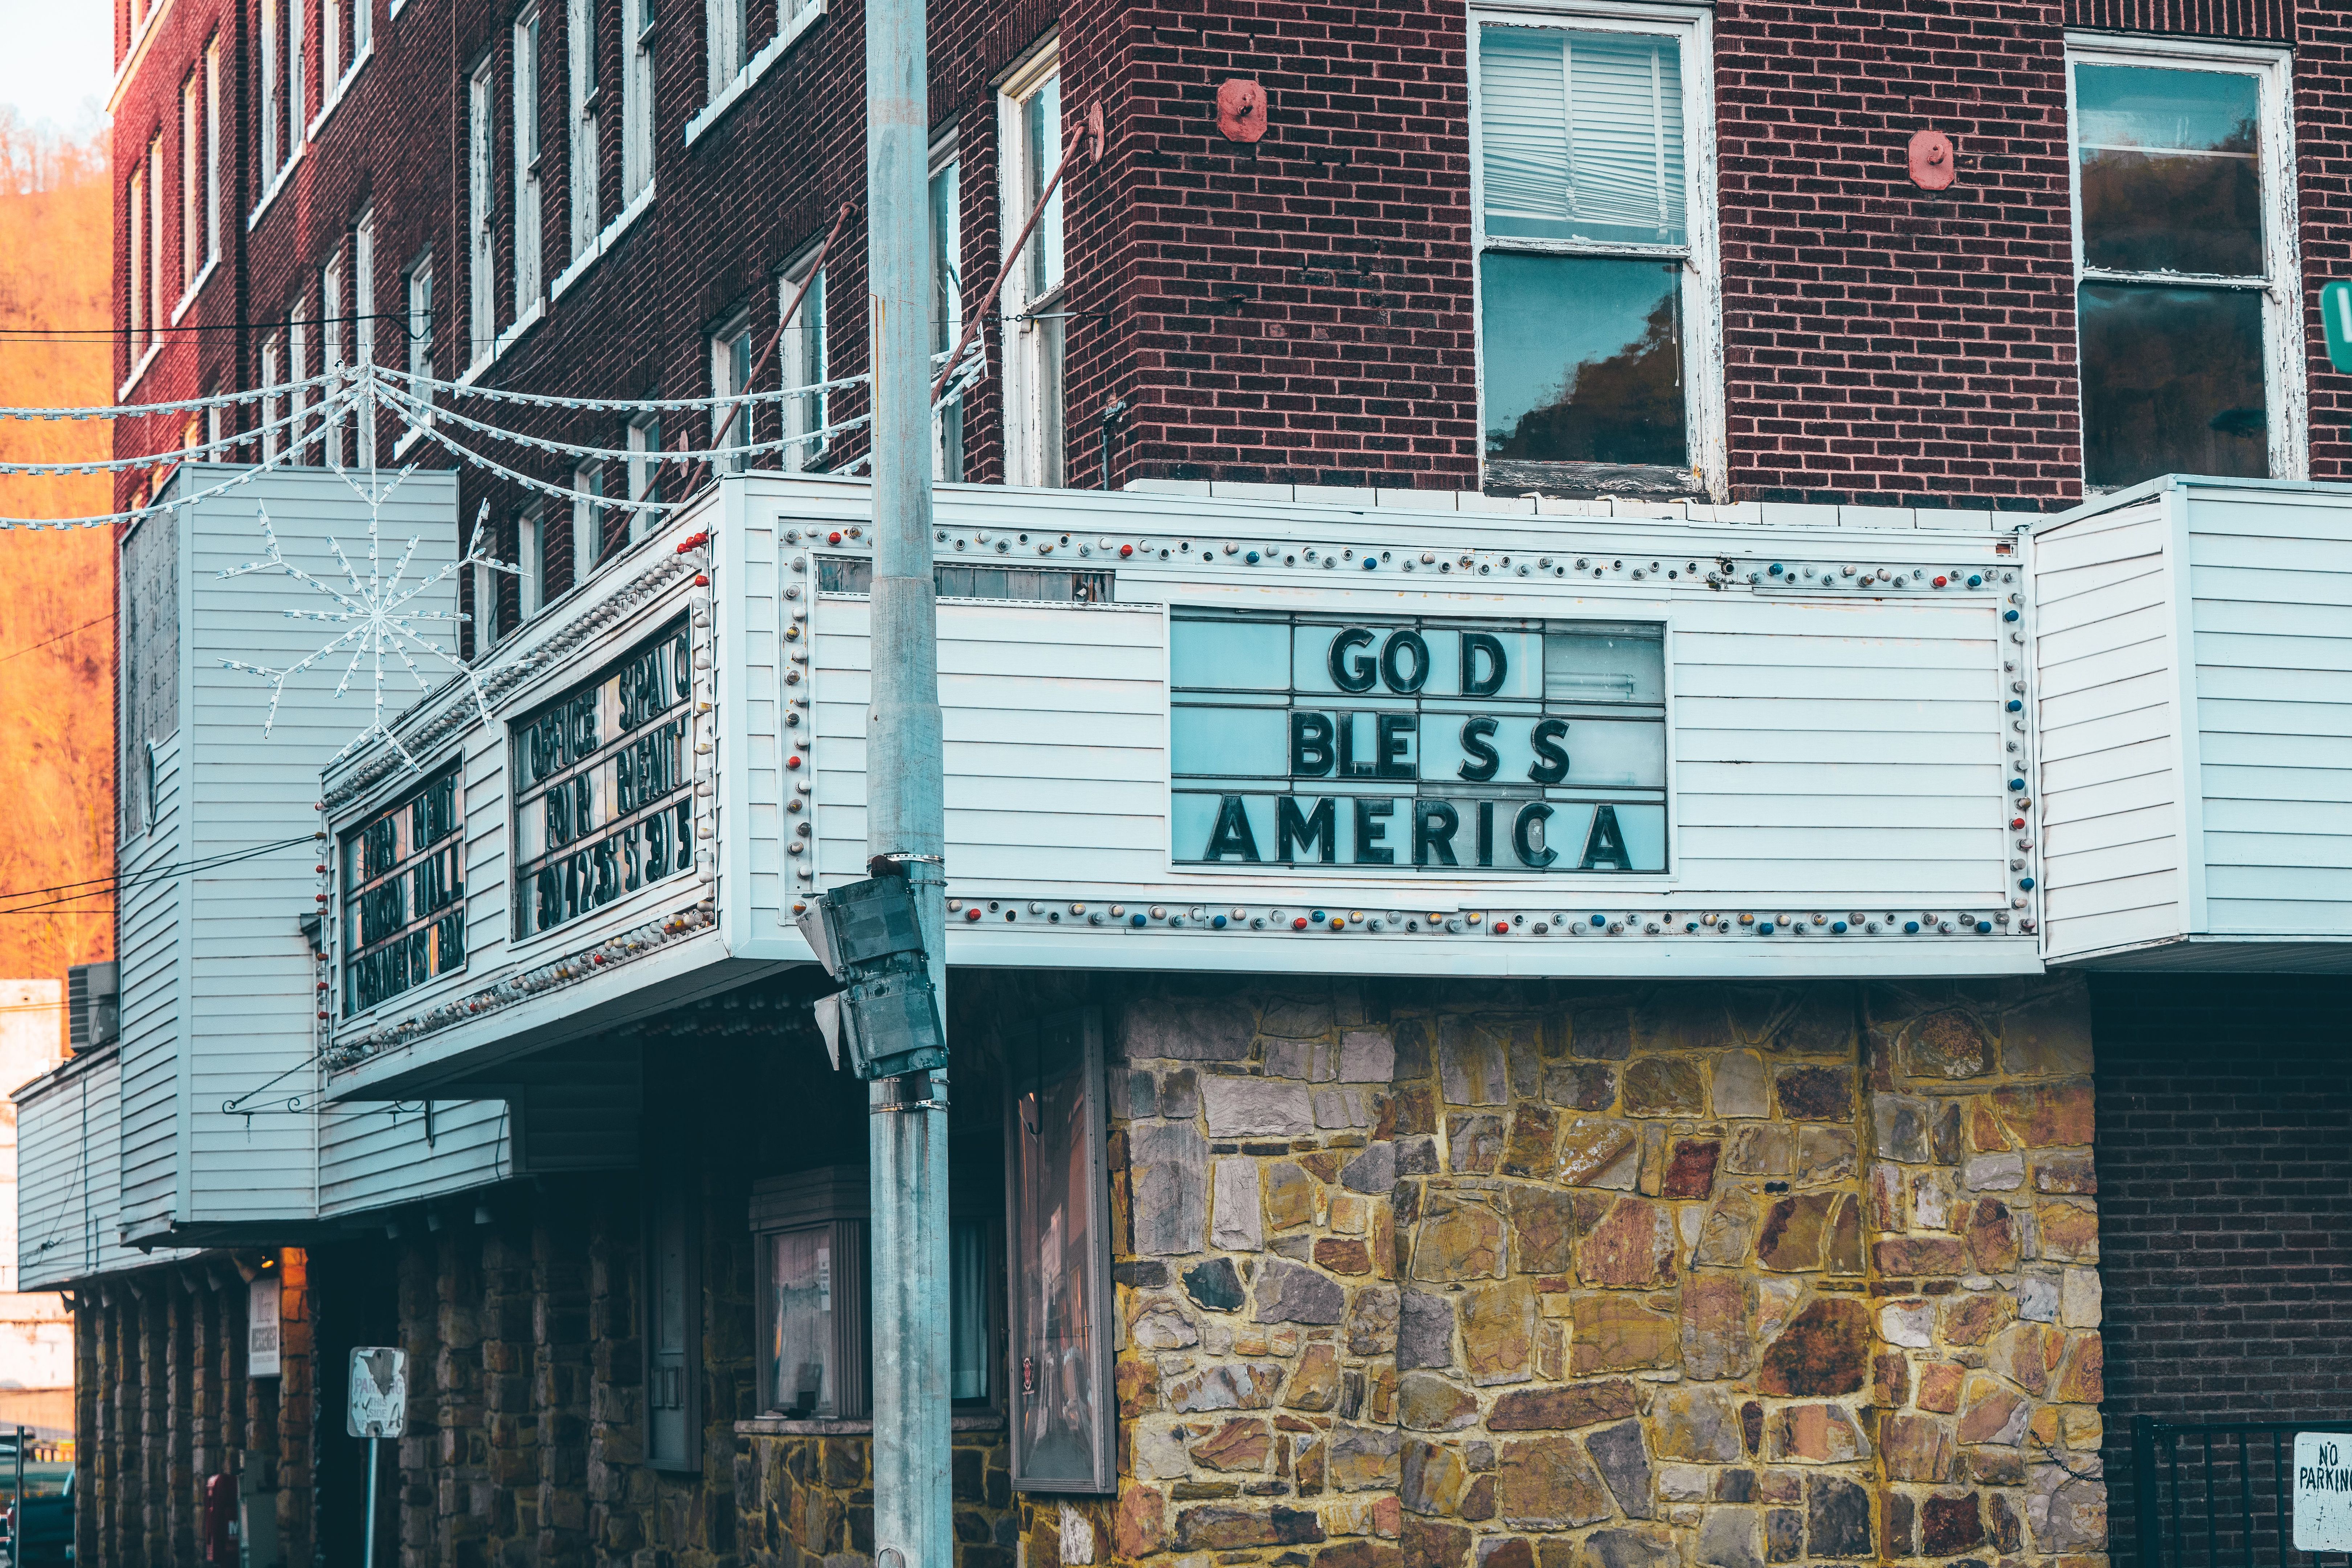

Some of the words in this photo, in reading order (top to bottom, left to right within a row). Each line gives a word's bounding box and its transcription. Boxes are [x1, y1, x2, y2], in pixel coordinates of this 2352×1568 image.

[1327, 626, 1507, 697] GOD
[531, 687, 595, 781] OFFICE
[1288, 709, 1570, 784] BLESS
[546, 772, 590, 849] FOR
[617, 716, 682, 815] RENT
[364, 816, 391, 879] FOR
[412, 775, 452, 851] RENT
[1203, 793, 1633, 870] AMERICA
[368, 1408, 387, 1418] SIDE
[2300, 1466, 2352, 1494] PARKIN
[2319, 1444, 2338, 1467] NO
